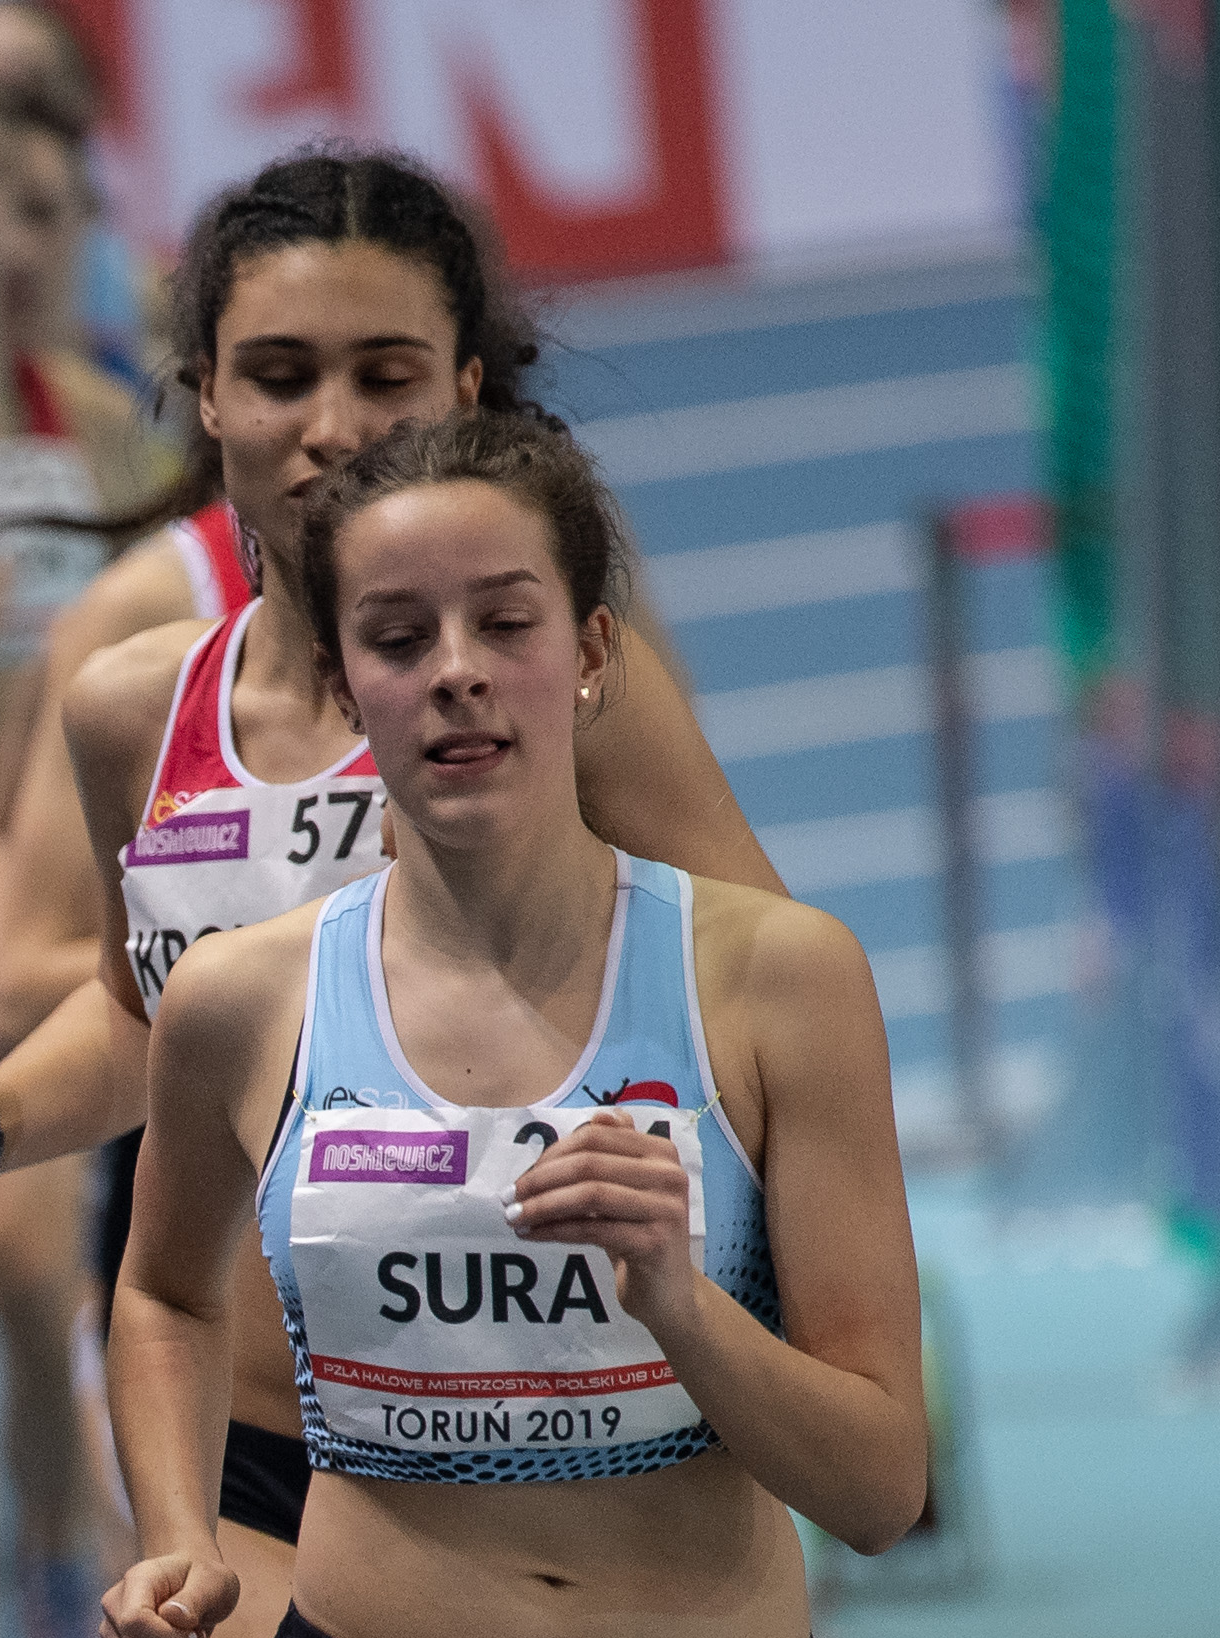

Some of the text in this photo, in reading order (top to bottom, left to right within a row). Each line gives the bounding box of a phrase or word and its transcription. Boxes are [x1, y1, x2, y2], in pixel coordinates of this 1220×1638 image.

[377, 1250, 611, 1325] SURA
[323, 1361, 361, 1380] PZLA
[362, 1370, 424, 1391] HALOWE
[427, 1378, 552, 1392] MISTRZOSTWA
[555, 1374, 615, 1391] POLSKI
[618, 1370, 649, 1386] U18
[380, 1400, 622, 1443] TORUŃ 2019
